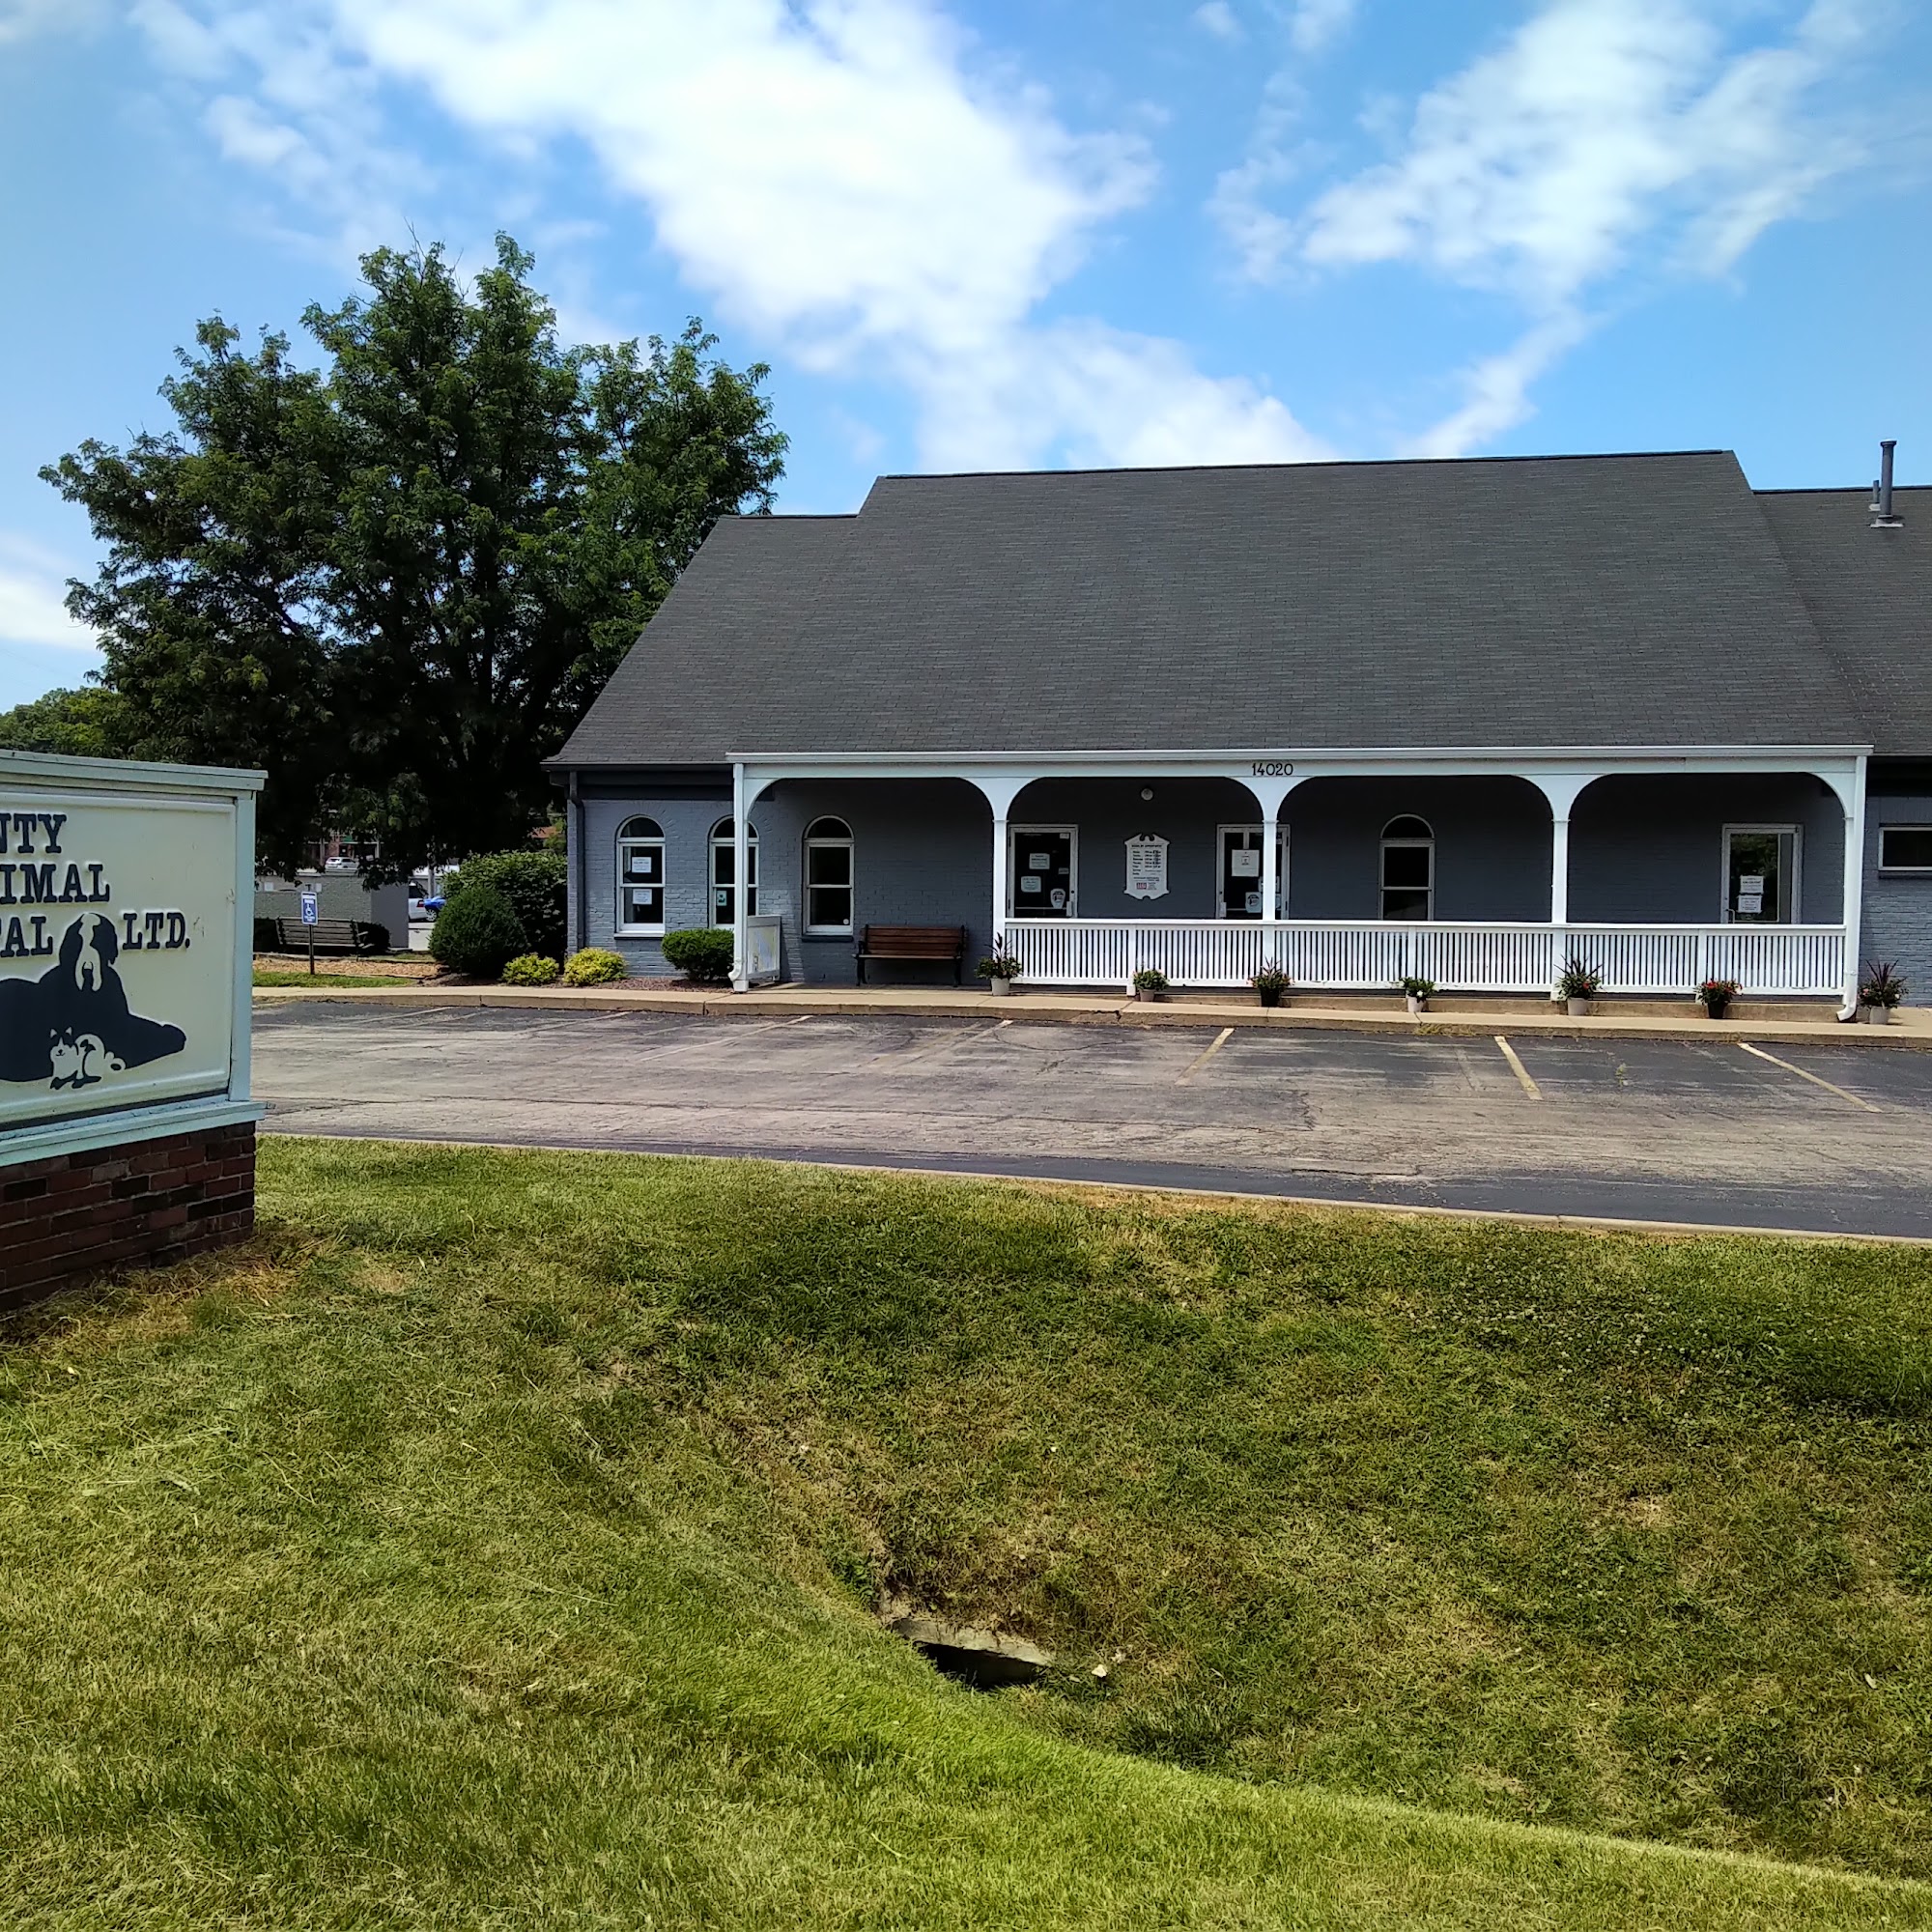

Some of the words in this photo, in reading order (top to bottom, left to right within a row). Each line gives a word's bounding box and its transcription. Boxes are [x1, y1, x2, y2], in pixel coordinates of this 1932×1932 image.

[1252, 762, 1294, 776] 14020
[0, 863, 110, 904] IMAL
[0, 916, 53, 957] AL
[122, 912, 190, 951] LTD.
